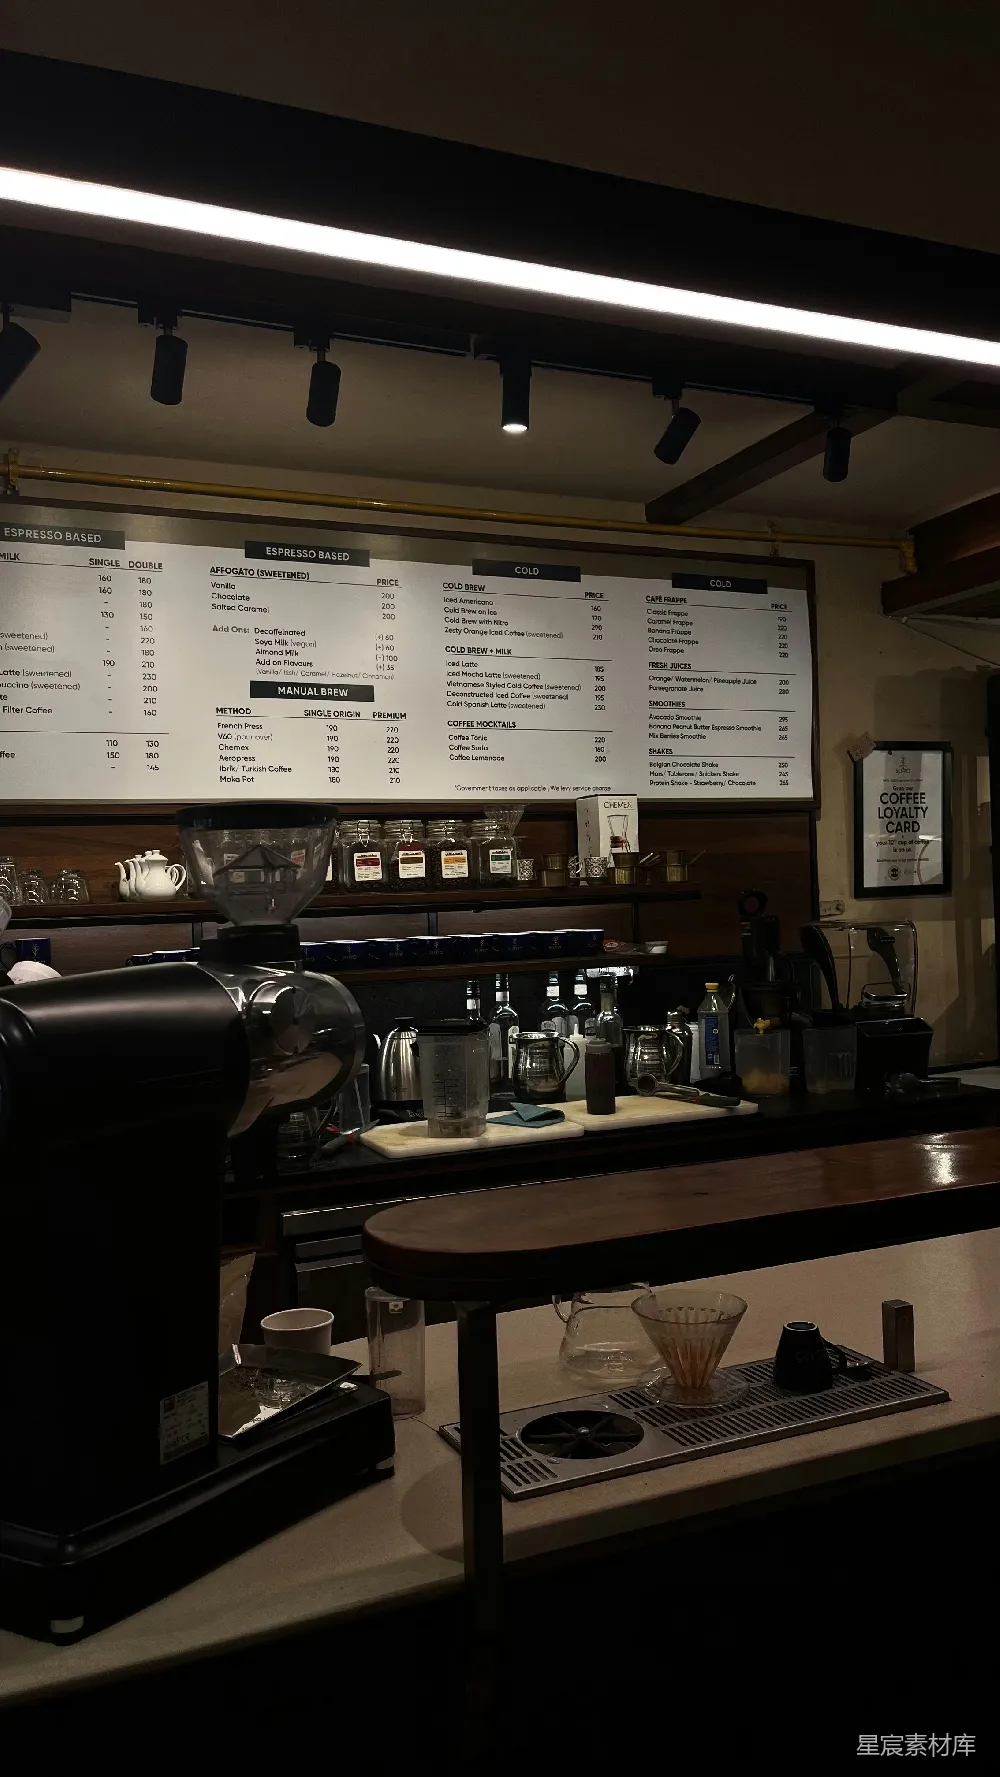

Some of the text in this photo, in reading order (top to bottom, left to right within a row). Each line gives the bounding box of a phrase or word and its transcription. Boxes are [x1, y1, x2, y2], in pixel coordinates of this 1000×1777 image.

[4, 527, 101, 543] ESPRESSO BASED
[266, 546, 350, 561] ESPRESSO BASED
[89, 558, 163, 569] SINGLE DOUBLE
[210, 566, 310, 580] AFFOGATO (SWEETENED)
[514, 566, 539, 575] COLD
[210, 582, 236, 590] Vanilla
[376, 578, 399, 586] PRICE
[710, 579, 732, 588] COLD
[464, 584, 486, 592] BREW
[254, 628, 306, 636] Decaffeinated
[274, 639, 289, 647] Milk
[467, 646, 488, 654] BREW
[102, 659, 115, 667] 190
[142, 673, 156, 681] 230
[278, 686, 349, 697] MANUAL BREW
[2, 706, 23, 714] Filter
[216, 707, 252, 715] METHOD
[303, 709, 332, 717] SINGLE
[217, 722, 243, 730] French
[447, 720, 474, 728] COFFEE
[268, 765, 292, 773] Coffee
[880, 792, 926, 804] COFFEE
[878, 807, 928, 819] LOYALTY
[886, 821, 920, 833] CARD
